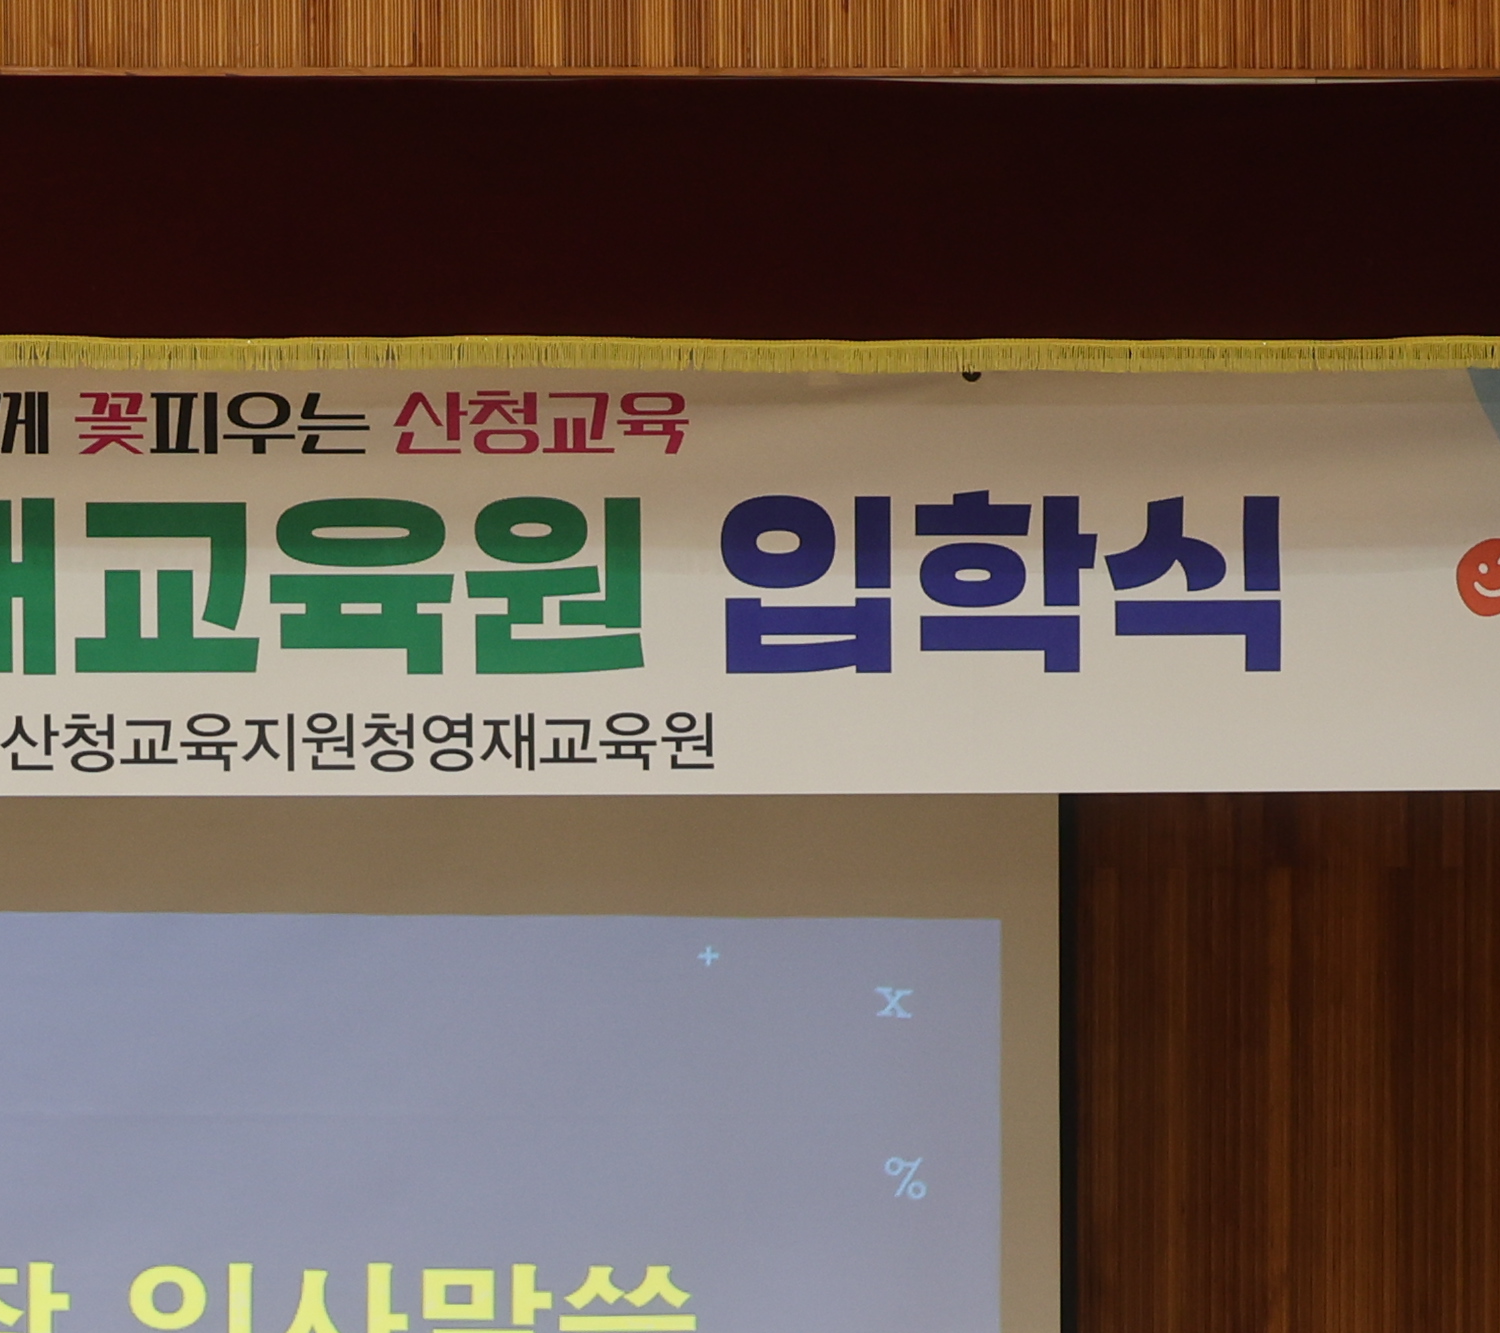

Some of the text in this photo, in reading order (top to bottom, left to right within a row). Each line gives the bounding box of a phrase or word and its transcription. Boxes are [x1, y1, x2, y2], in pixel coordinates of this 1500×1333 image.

[74, 391, 370, 455] 꽃피우는
[394, 391, 689, 455] 산청교육
[720, 490, 1281, 674] 입학식
[0, 711, 715, 774] 산청교육지원청영재교육원
